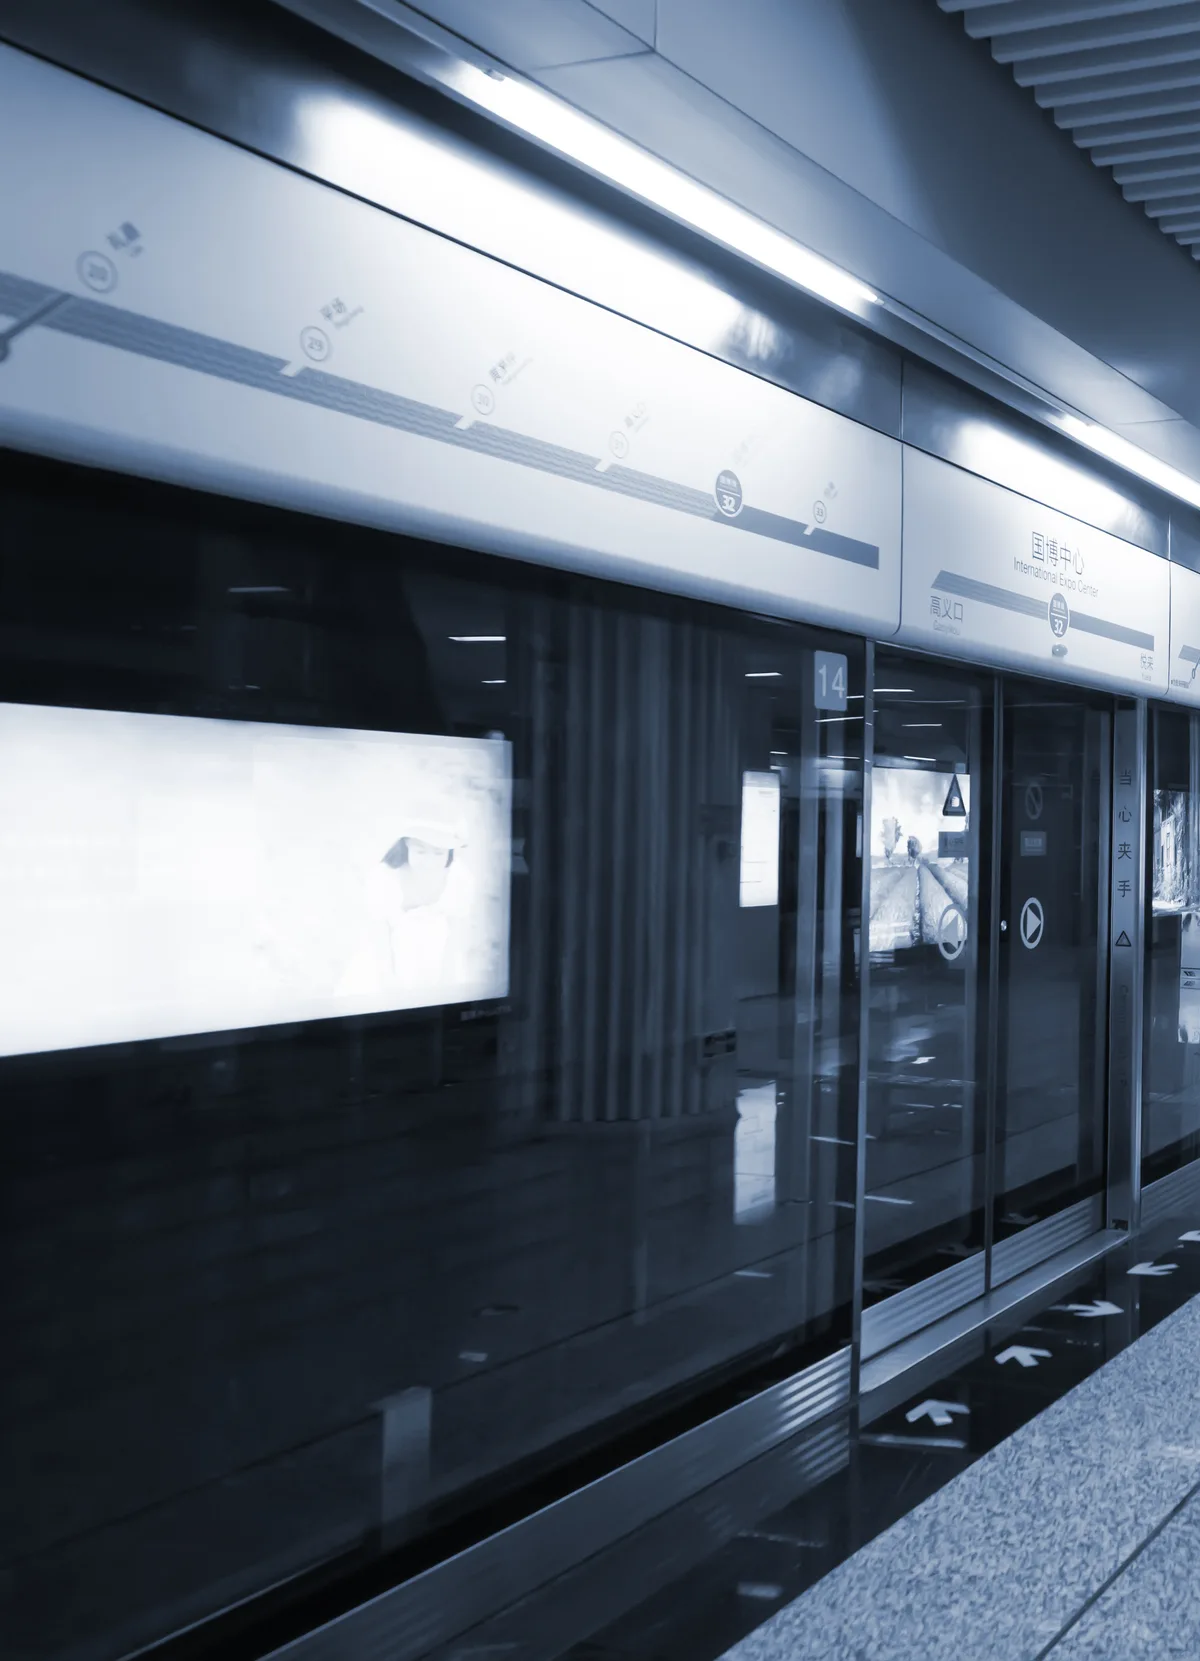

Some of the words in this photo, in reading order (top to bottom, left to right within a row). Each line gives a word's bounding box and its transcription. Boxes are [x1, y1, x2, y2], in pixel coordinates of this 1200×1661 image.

[721, 493, 737, 513] 32
[1032, 531, 1084, 576] 国博中心
[1013, 556, 1058, 585] International
[1059, 572, 1077, 591] Expo
[1077, 579, 1099, 598] Center
[930, 595, 964, 623] 高义口
[1054, 618, 1064, 636] 32
[818, 663, 846, 700] 14
[1117, 769, 1132, 898] 当心夹手
